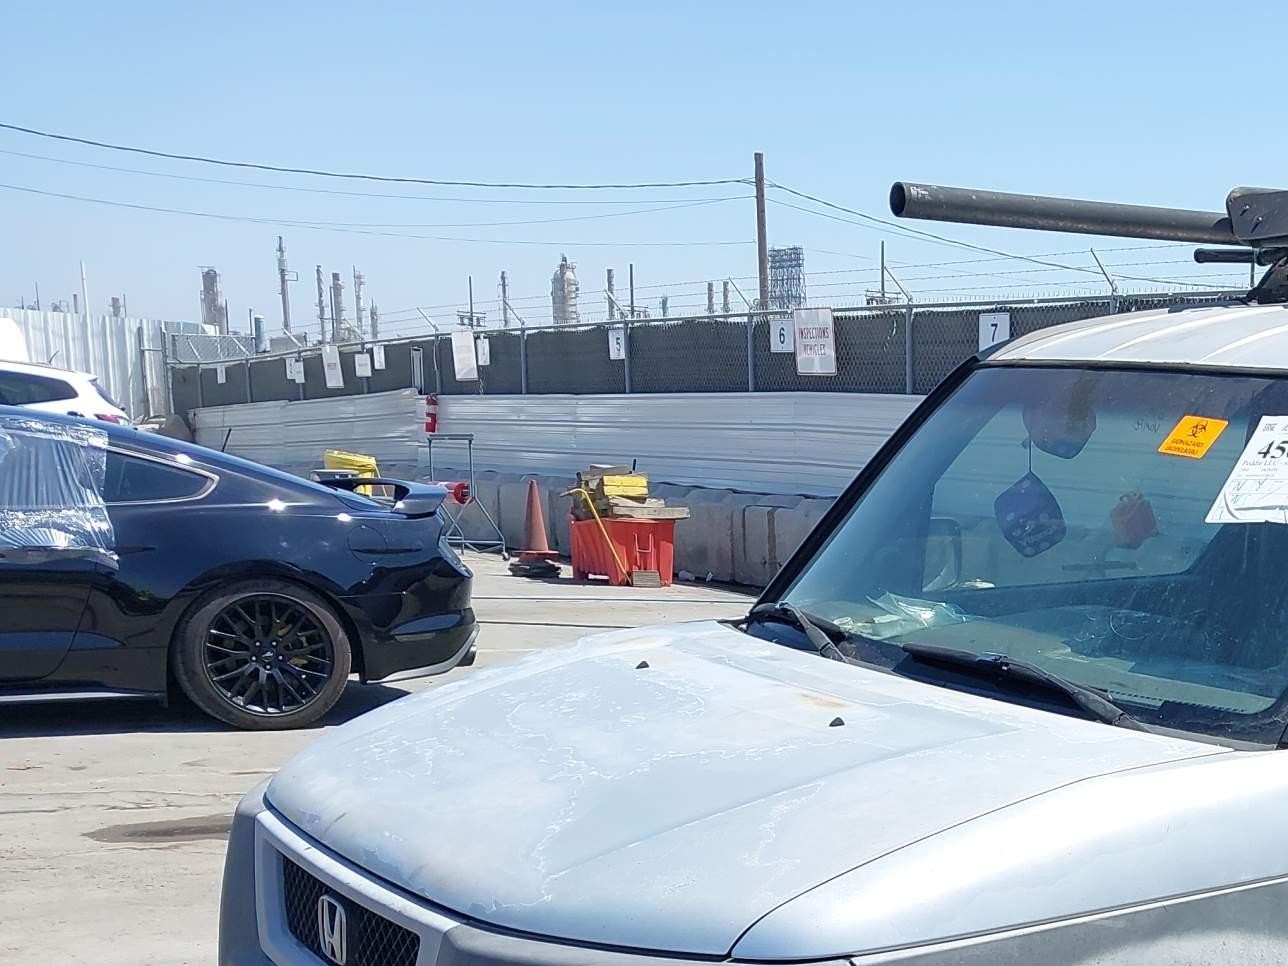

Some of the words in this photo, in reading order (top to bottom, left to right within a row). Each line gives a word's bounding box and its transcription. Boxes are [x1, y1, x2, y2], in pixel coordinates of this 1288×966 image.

[778, 327, 786, 345] 6
[990, 323, 998, 342] 7
[615, 336, 622, 352] 5
